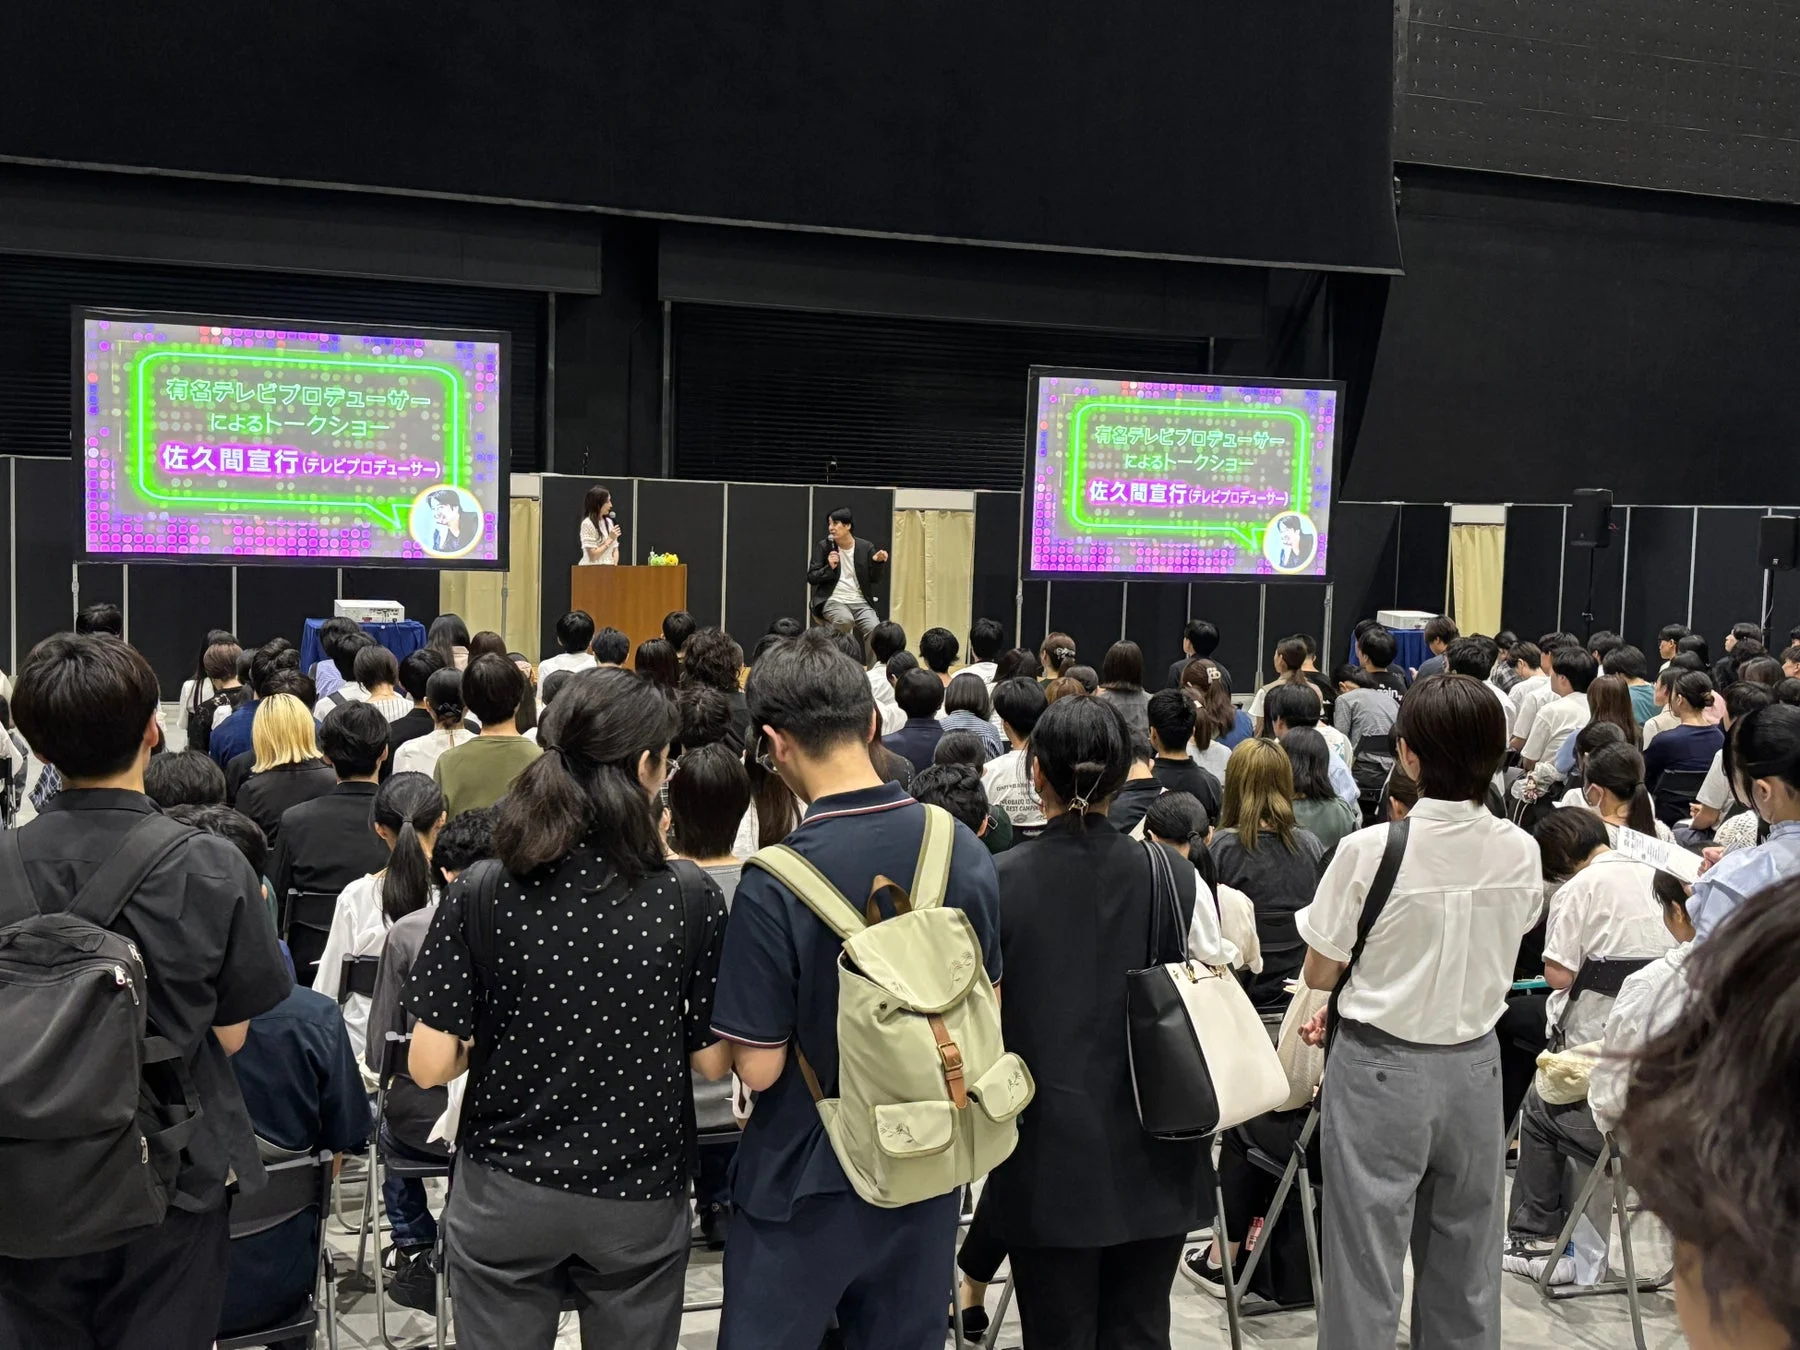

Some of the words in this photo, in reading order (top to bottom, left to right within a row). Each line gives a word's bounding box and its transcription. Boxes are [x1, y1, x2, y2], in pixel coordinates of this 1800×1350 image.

[165, 377, 431, 411] 有名テレビプロデューサー
[210, 411, 390, 437] によるトークショー
[1094, 425, 1285, 450] 有名テレビプロデューサー
[1124, 452, 1255, 472] によるトークショー
